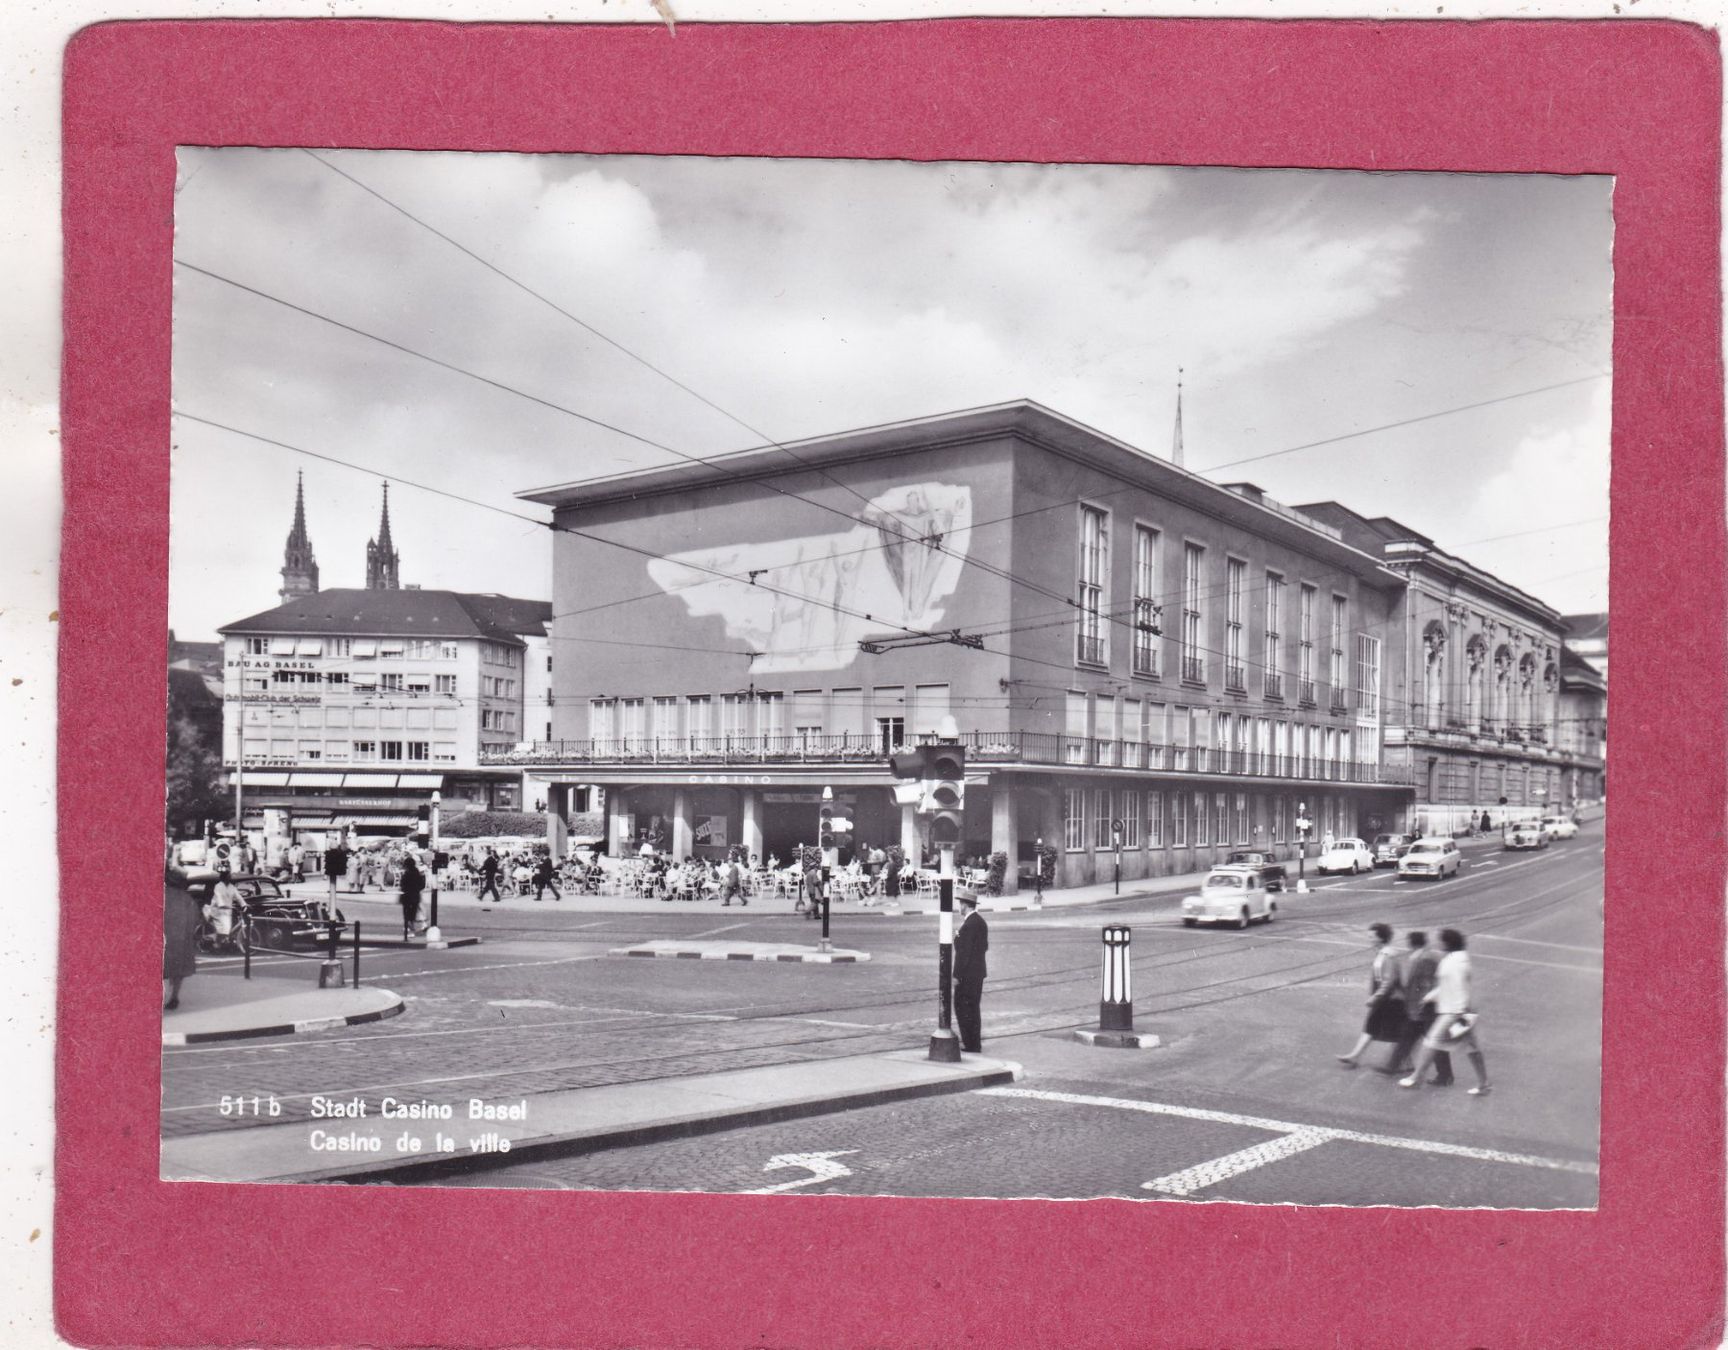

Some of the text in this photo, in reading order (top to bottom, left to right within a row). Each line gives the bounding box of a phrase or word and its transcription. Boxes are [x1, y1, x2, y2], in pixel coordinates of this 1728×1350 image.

[228, 660, 315, 669] BAU AG BASEL
[688, 774, 772, 784] CASINO
